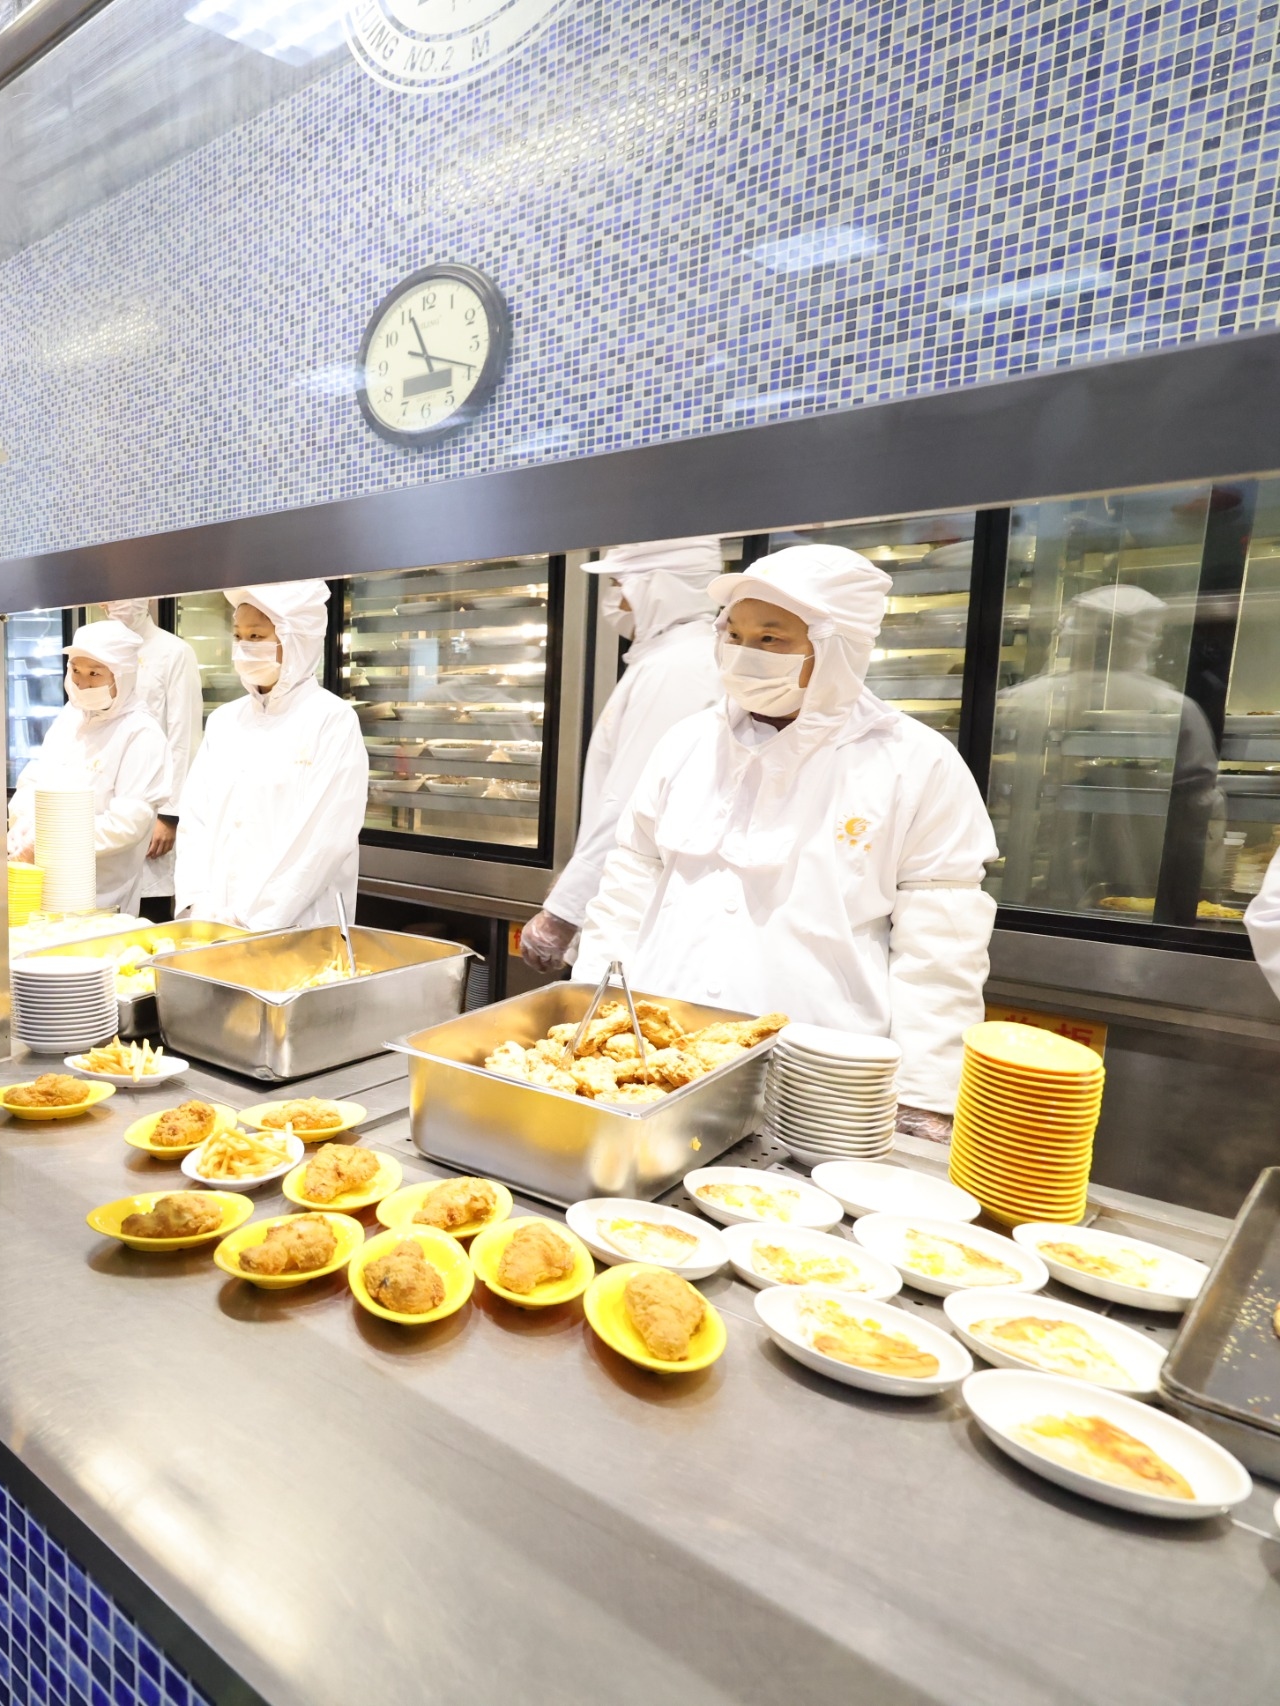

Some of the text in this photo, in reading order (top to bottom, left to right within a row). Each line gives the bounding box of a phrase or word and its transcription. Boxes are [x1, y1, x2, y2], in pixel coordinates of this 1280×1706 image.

[403, 46, 455, 73] NO.2
[422, 292, 437, 311] 12
[450, 293, 455, 310] 1
[401, 308, 412, 325] 11
[464, 307, 476, 326] 2
[385, 331, 399, 348] 10
[469, 334, 480, 352] 3
[378, 360, 389, 377] 9
[383, 386, 393, 403] 8
[444, 390, 455, 407] 5
[401, 400, 409, 417] 7
[420, 402, 431, 419] 6
